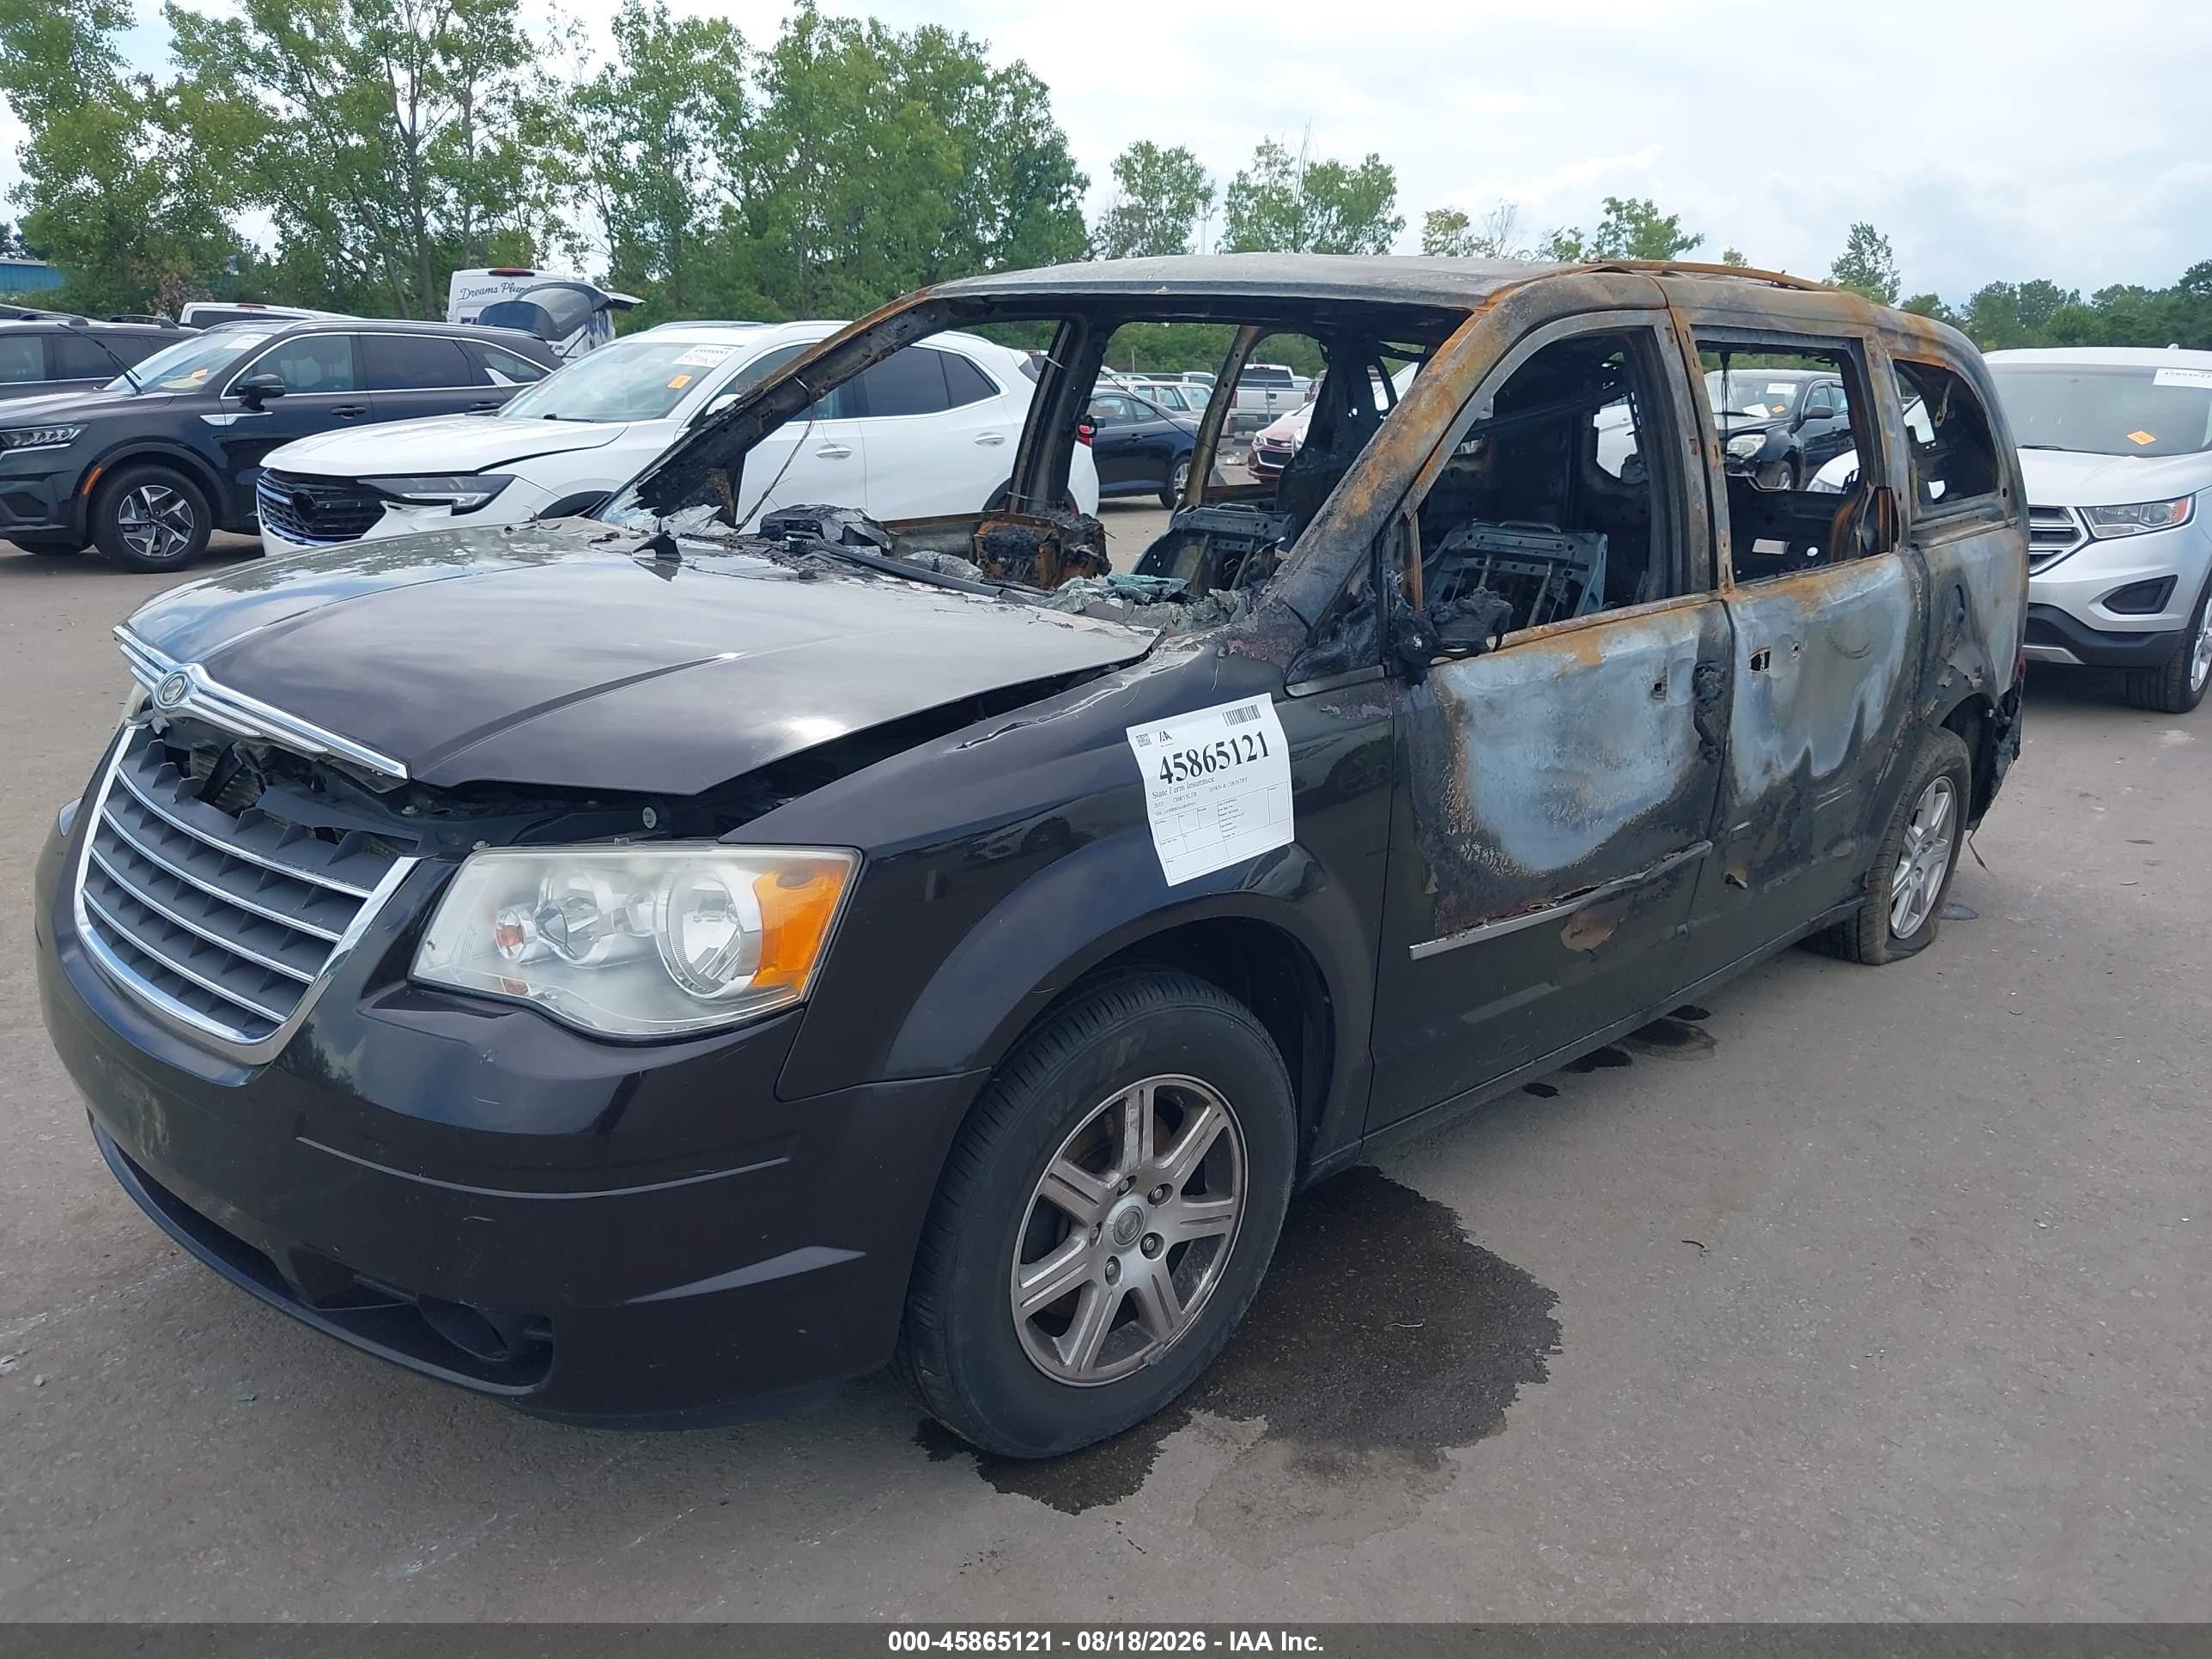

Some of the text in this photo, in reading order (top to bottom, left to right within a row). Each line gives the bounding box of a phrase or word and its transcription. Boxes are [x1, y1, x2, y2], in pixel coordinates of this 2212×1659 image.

[457, 286, 498, 301] Dreams
[1159, 731, 1271, 785] 45865121
[1152, 776, 1215, 799] State Farm Insurance
